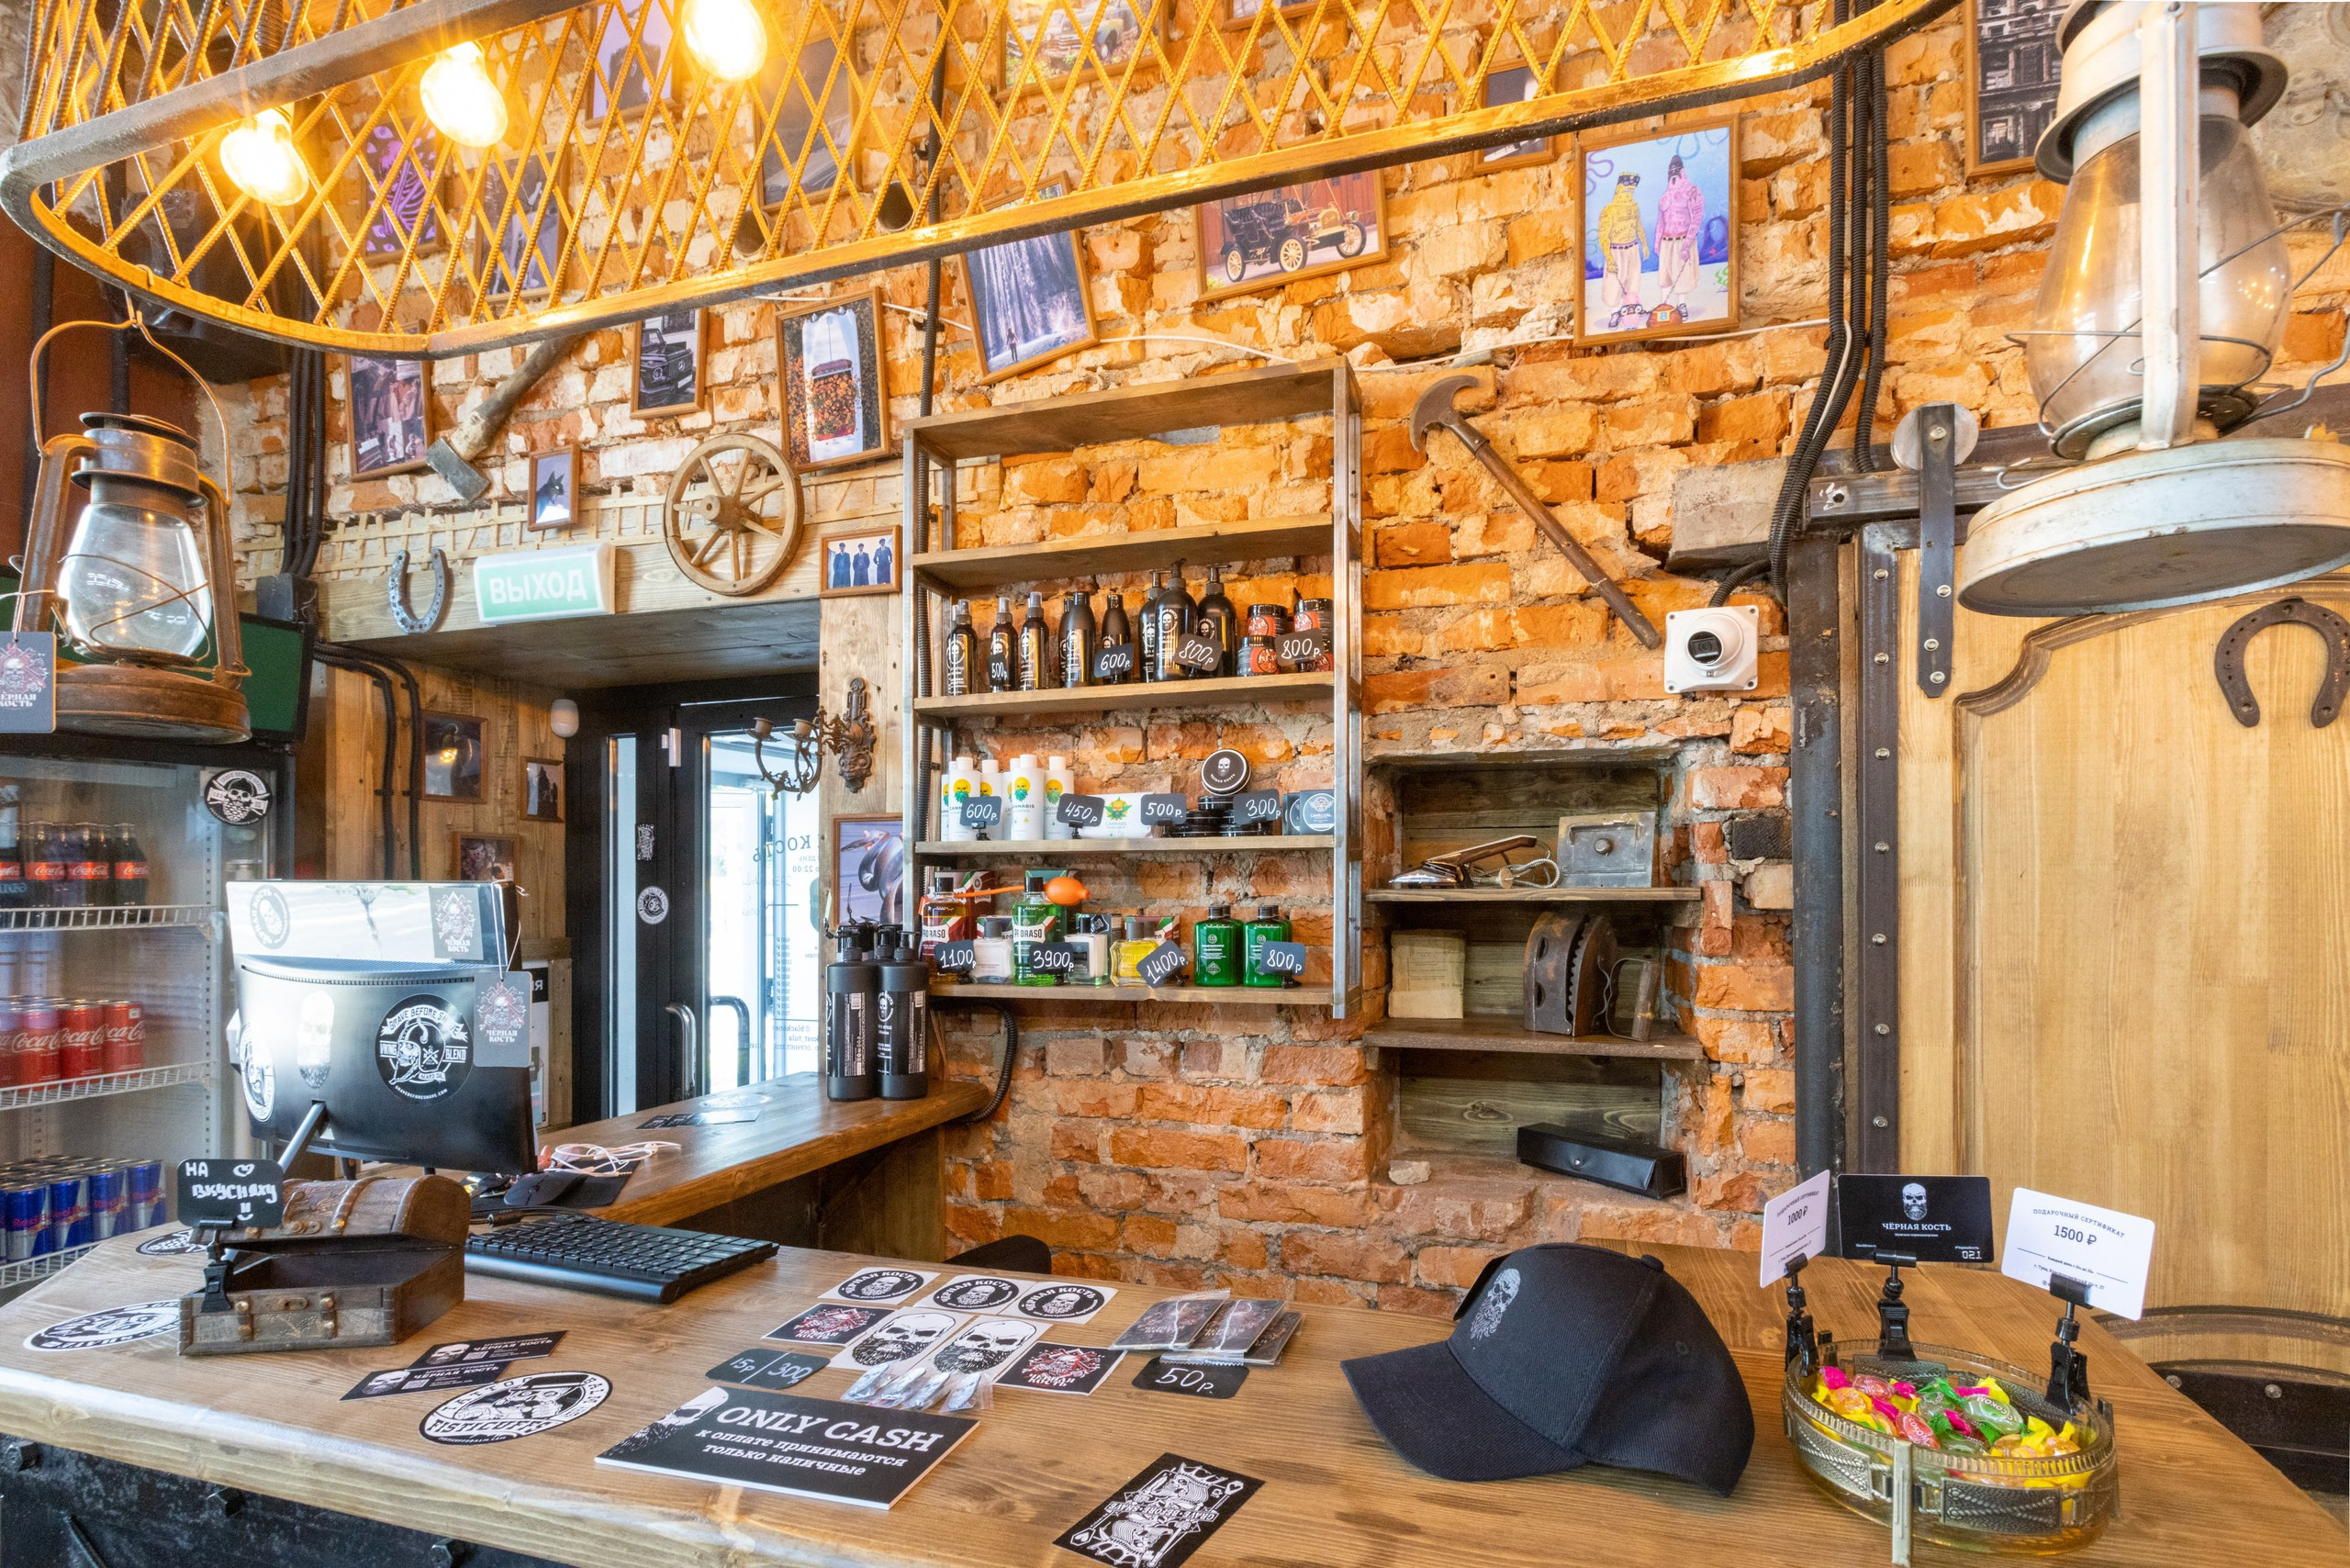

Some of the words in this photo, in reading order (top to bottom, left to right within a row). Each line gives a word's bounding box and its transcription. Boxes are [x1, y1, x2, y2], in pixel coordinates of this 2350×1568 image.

[488, 568, 588, 605] ВЫХОД
[0, 690, 36, 700] ЁРНАЯ
[410, 1006, 438, 1021] BEFORE
[487, 1026, 518, 1037] ЧЁРНАЯ
[489, 1034, 516, 1043] КОСТЬ
[445, 1048, 466, 1060] BLEND
[185, 1161, 209, 1178] НА
[1787, 1207, 1803, 1226] 1000
[1882, 1222, 1919, 1231] ЧЁРНАЯ
[1921, 1223, 1952, 1231] КОСТЬ
[2032, 1208, 2079, 1221] ПОДАРОЧНЫЙ
[2080, 1215, 2126, 1239] СЕРТИФИКАТ
[2053, 1225, 2084, 1243] 1500
[2087, 1234, 2098, 1246] ₽
[1962, 1250, 1983, 1260] 021
[882, 1271, 916, 1282] КОСТЬ
[975, 1280, 1012, 1291] КОСТЬ
[1058, 1287, 1094, 1300] КОСТЬ
[474, 1342, 516, 1351] ЧЁРНАЯ
[519, 1339, 553, 1348] КОСТЬ
[413, 1370, 461, 1380] ЧЁРНАЯ
[463, 1366, 499, 1374] КОСТЬ
[1155, 1367, 1214, 1394] 50р.
[427, 1418, 551, 1434] FISTICUFFS
[717, 1406, 830, 1435] ONLY
[824, 1420, 945, 1452] CASH
[1908, 1417, 1931, 1444] СОКОМ
[695, 1428, 710, 1438] к
[711, 1430, 774, 1448] оплате
[770, 1440, 909, 1468] принимаются
[702, 1443, 770, 1465] только
[769, 1452, 867, 1476] наличные
[1108, 1502, 1140, 1512] SHAVE
[1143, 1506, 1180, 1517] BEFORE
[1181, 1511, 1215, 1521] GRAVE
